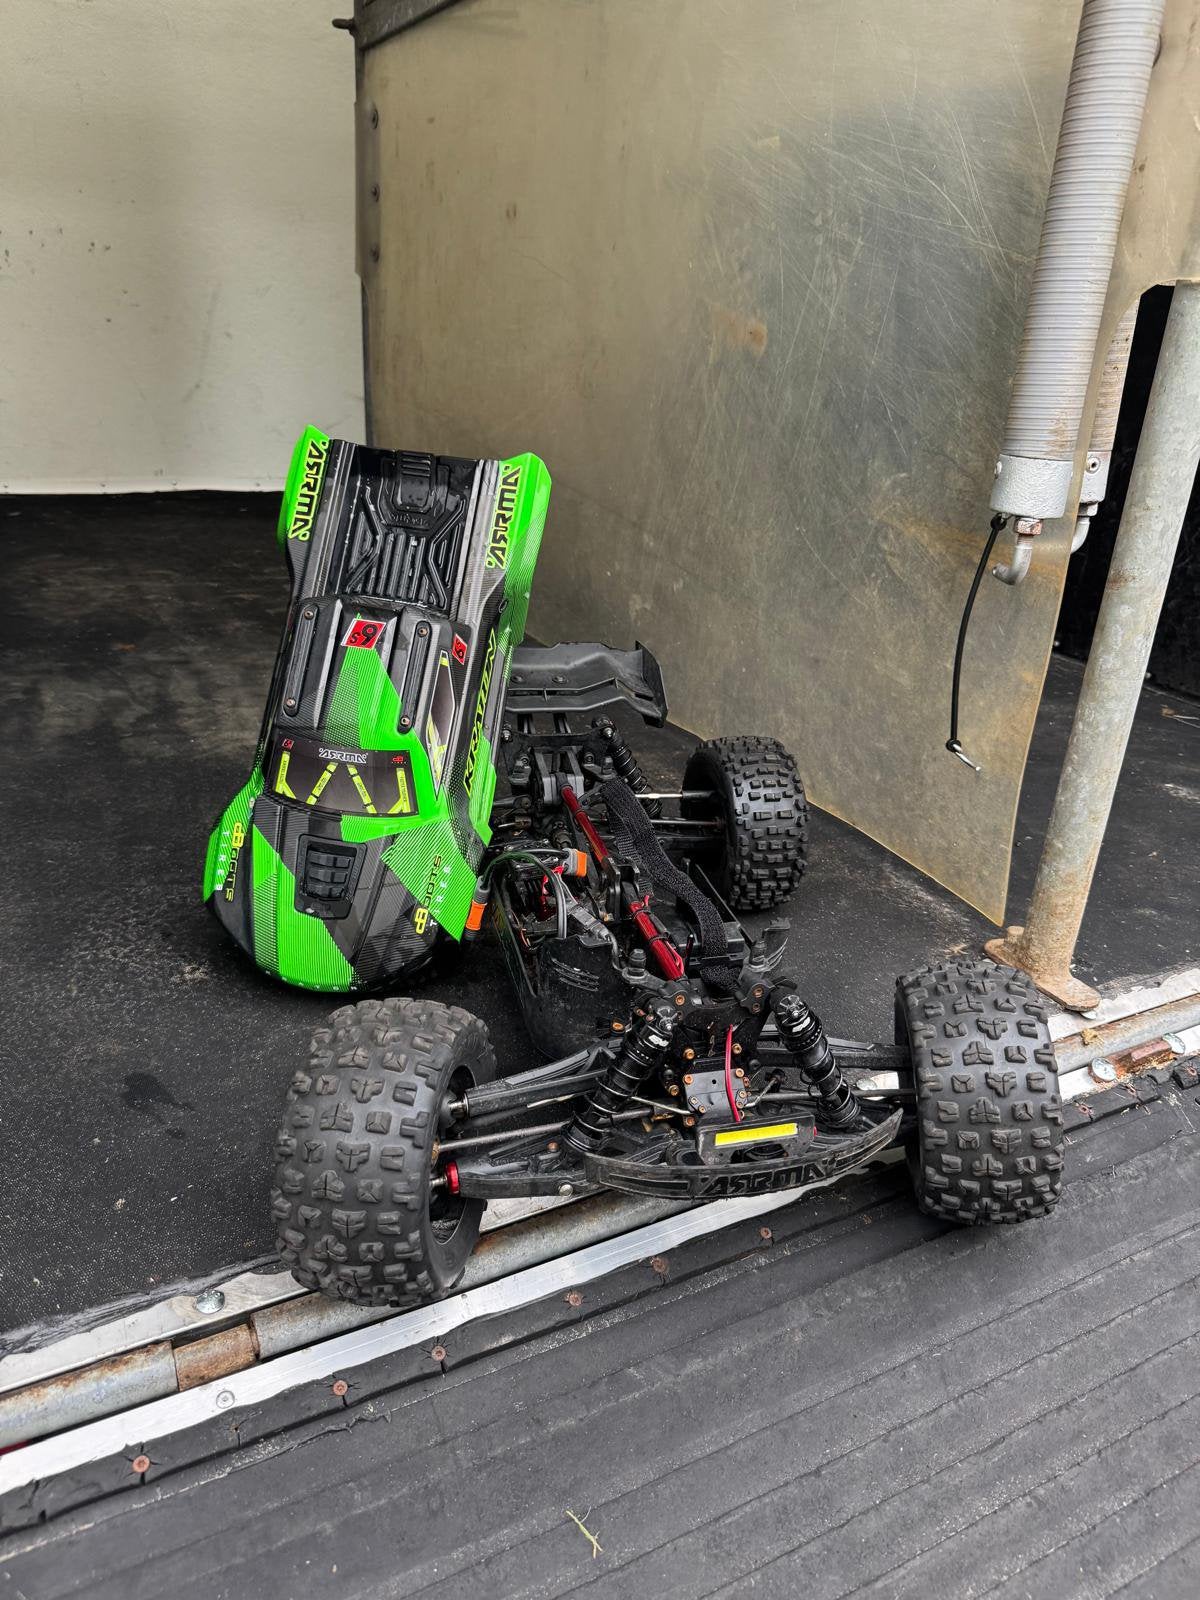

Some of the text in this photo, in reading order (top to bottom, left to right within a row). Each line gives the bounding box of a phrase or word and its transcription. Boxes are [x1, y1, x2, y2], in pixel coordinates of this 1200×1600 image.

[288, 439, 328, 540] ARRMA
[486, 465, 521, 568] ARRMA
[318, 747, 369, 763] ARRMA
[463, 628, 497, 797] KRATON
[699, 1160, 832, 1195] ARRMA
